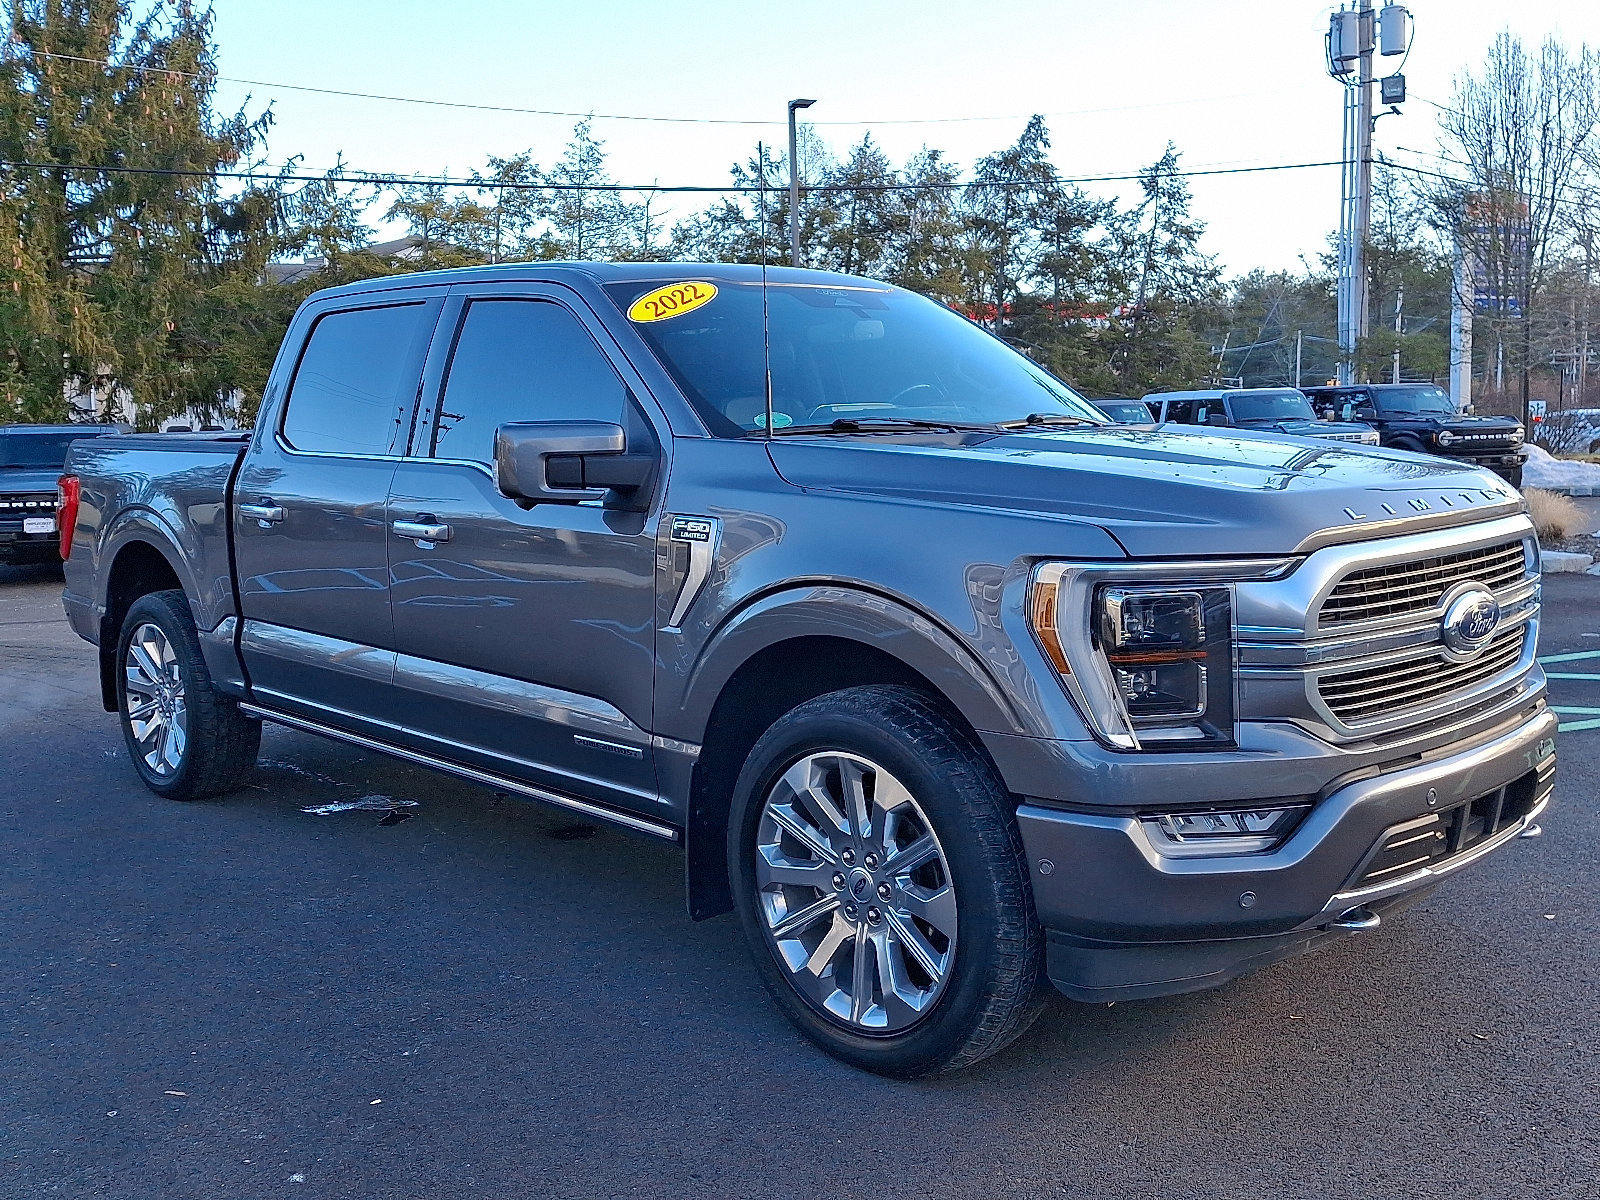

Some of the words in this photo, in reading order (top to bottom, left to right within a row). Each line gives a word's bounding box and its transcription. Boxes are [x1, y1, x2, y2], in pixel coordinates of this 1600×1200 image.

[645, 285, 705, 317] 2022
[680, 531, 707, 539] LIMITED
[1469, 608, 1495, 636] Ford
